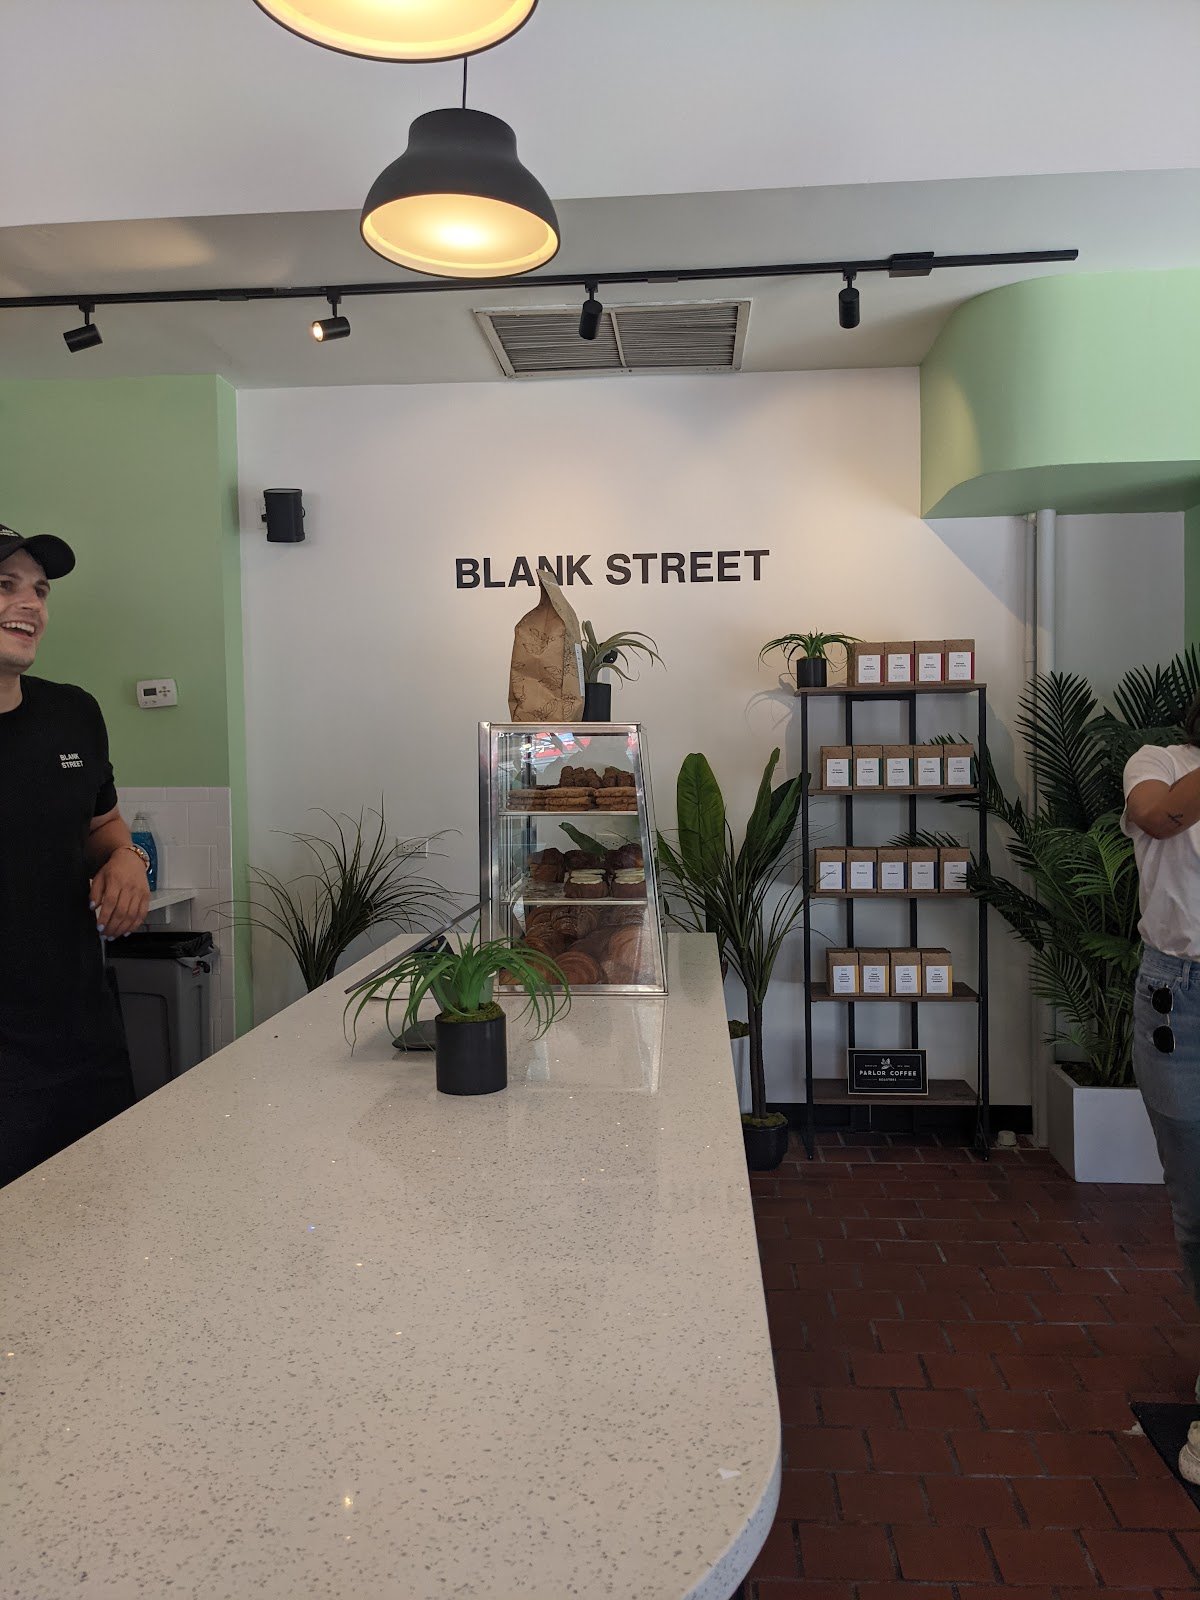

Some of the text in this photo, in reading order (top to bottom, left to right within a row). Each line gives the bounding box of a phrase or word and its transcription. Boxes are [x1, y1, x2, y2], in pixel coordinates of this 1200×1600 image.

[455, 549, 770, 589] BLANK STREET
[59, 753, 80, 761] BLANK
[61, 760, 84, 768] STREET
